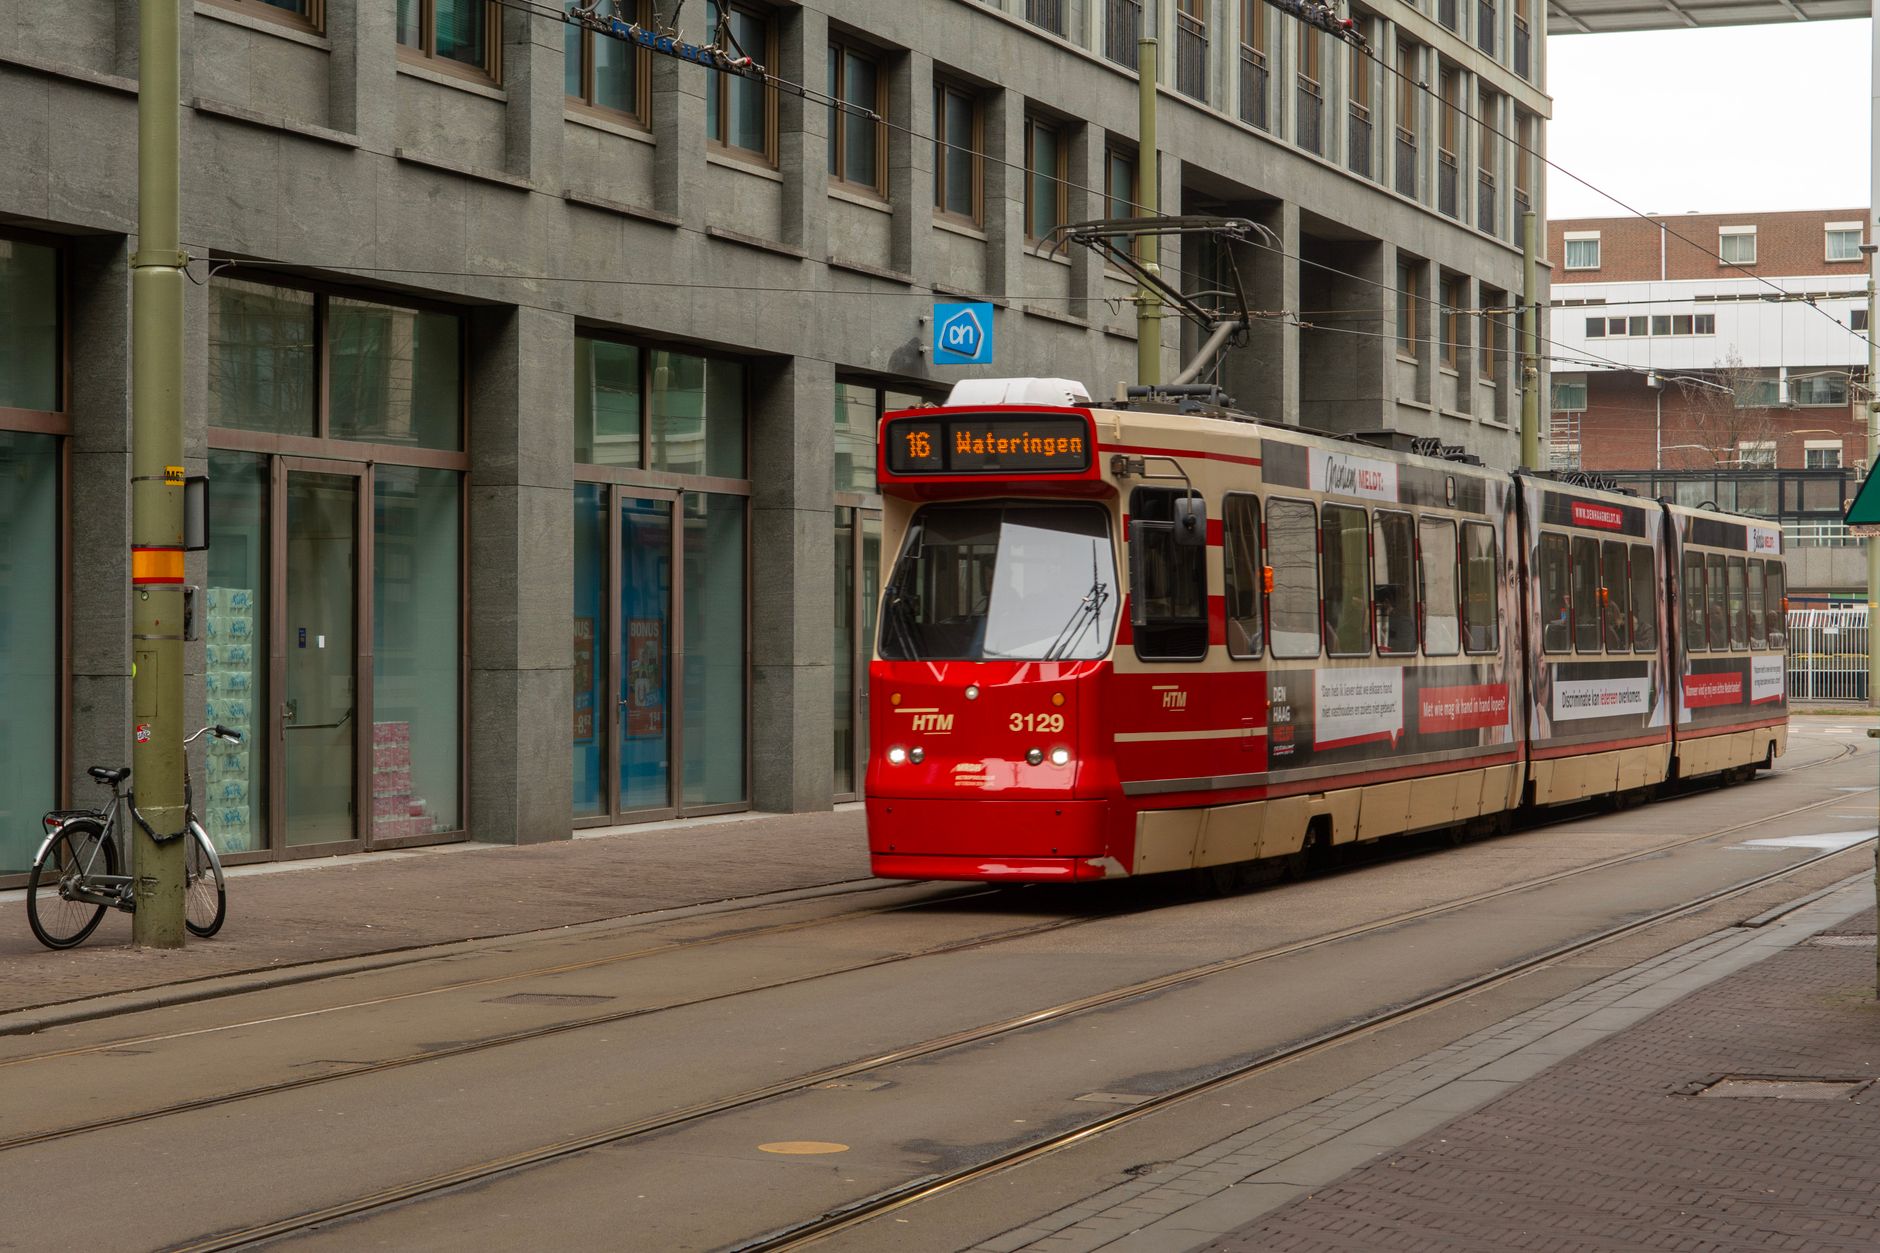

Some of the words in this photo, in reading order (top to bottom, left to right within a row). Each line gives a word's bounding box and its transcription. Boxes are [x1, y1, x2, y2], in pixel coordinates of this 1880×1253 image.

[906, 432, 930, 458] 16
[956, 431, 1082, 456] Wateringen
[1359, 470, 1384, 492] MELDT:
[1576, 507, 1622, 525] WWW.DENHAAGMELDT.NL
[631, 622, 658, 637] BONUS
[1162, 692, 1187, 708] HTM
[1273, 686, 1286, 702] DEN
[1562, 688, 1591, 708] Discriminatie
[1600, 688, 1618, 705] iedereen
[1619, 687, 1642, 704] overkomen.
[1273, 705, 1290, 722] HAAG
[1424, 702, 1433, 717] Met
[1435, 701, 1443, 716] wie
[1444, 703, 1454, 720] mag
[1455, 699, 1460, 714] ik
[1461, 698, 1472, 713] hand
[1473, 697, 1478, 713] in
[1479, 696, 1490, 712] hand
[1491, 696, 1505, 715] lopen?
[912, 714, 954, 730] HTM
[1009, 713, 1064, 732] 3129
